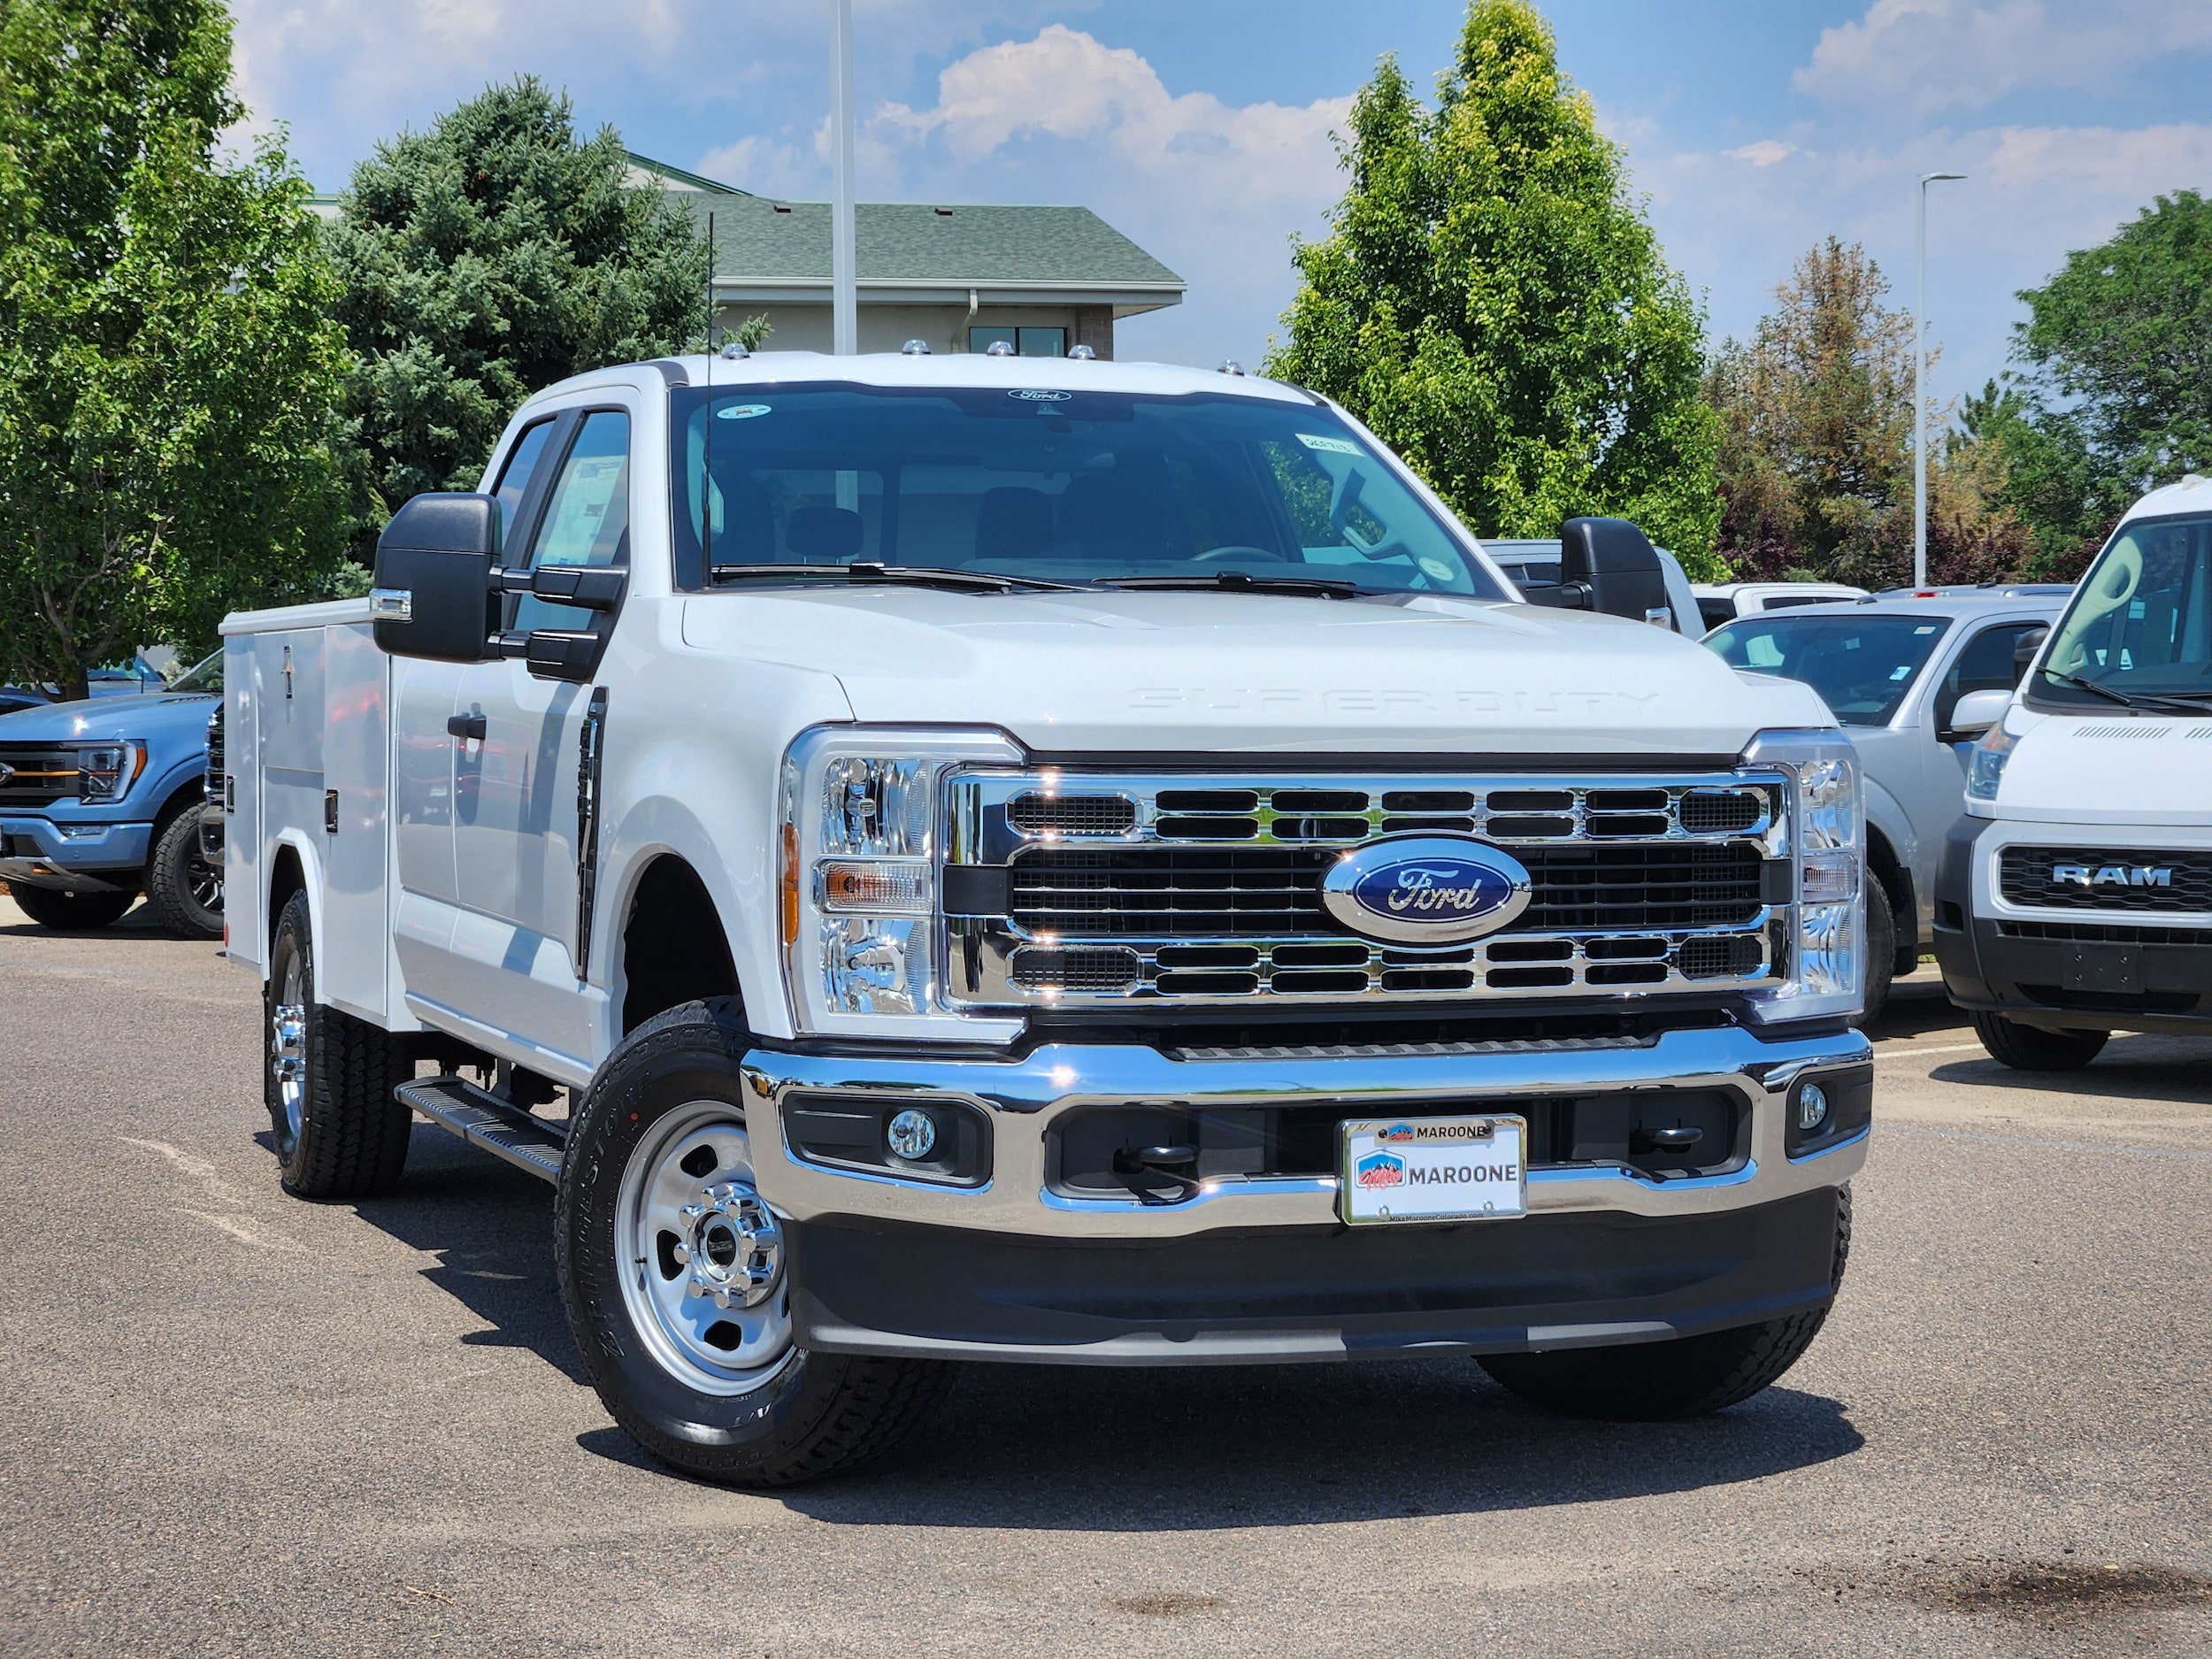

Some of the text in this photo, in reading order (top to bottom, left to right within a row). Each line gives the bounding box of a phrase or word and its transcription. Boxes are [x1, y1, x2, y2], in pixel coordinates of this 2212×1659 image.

[1019, 390, 1061, 400] Ford
[1127, 688, 1660, 714] SUPER DUTY
[2053, 865, 2172, 887] RAM
[1387, 868, 1482, 910] Ford
[1417, 1125, 1486, 1138] MAROONE
[1409, 1164, 1517, 1186] MAROONE
[1389, 1213, 1484, 1222] MikeMarooneColorado.com
